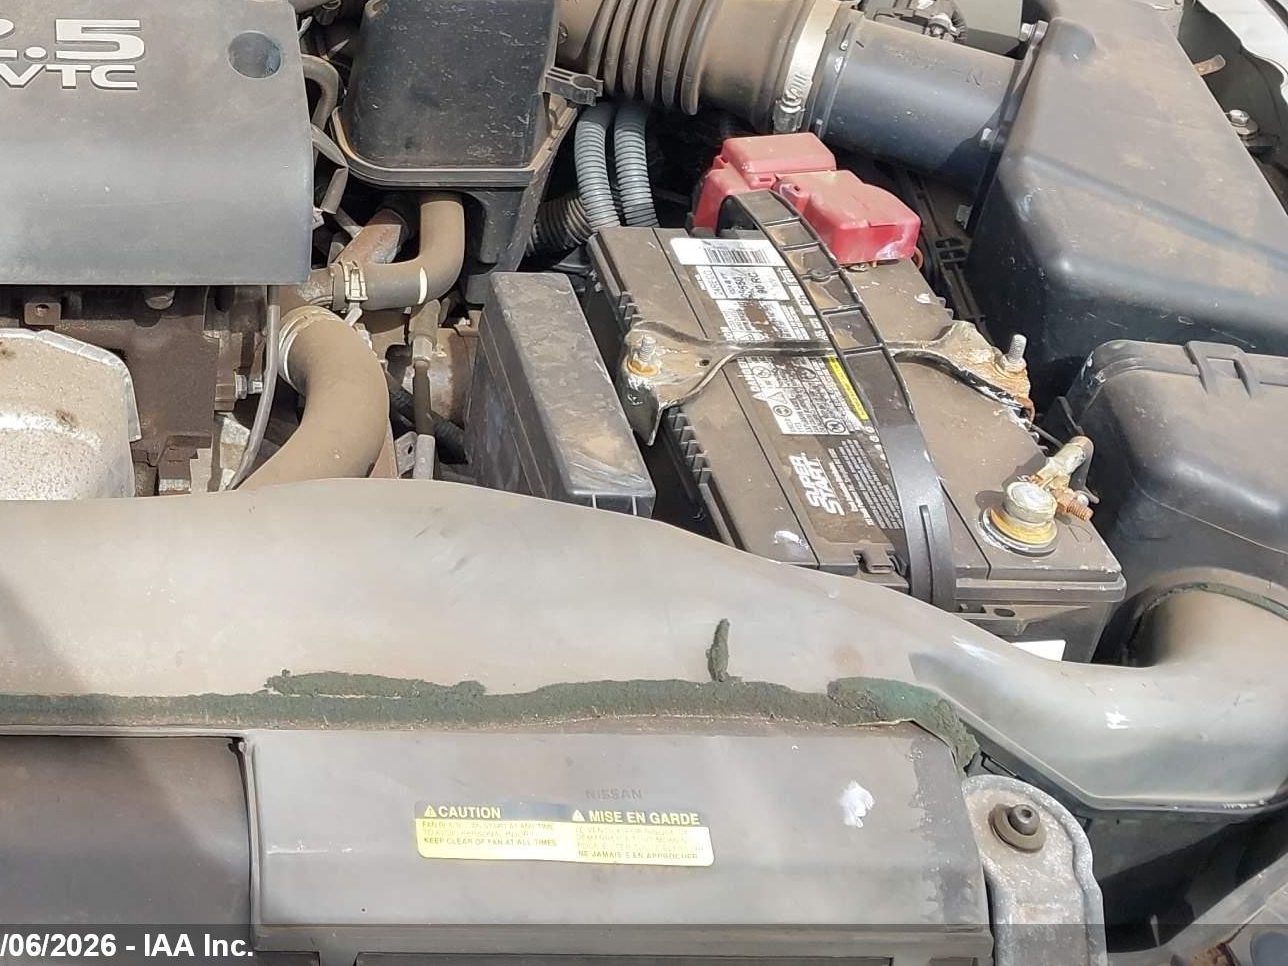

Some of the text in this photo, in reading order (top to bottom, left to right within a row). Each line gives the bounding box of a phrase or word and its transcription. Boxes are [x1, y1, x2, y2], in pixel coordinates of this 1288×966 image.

[789, 454, 823, 508] SUPER
[804, 457, 845, 516] START
[584, 788, 643, 801] NISSAN
[438, 806, 502, 819] CAUTION
[588, 810, 701, 826] MISE EN GARDE
